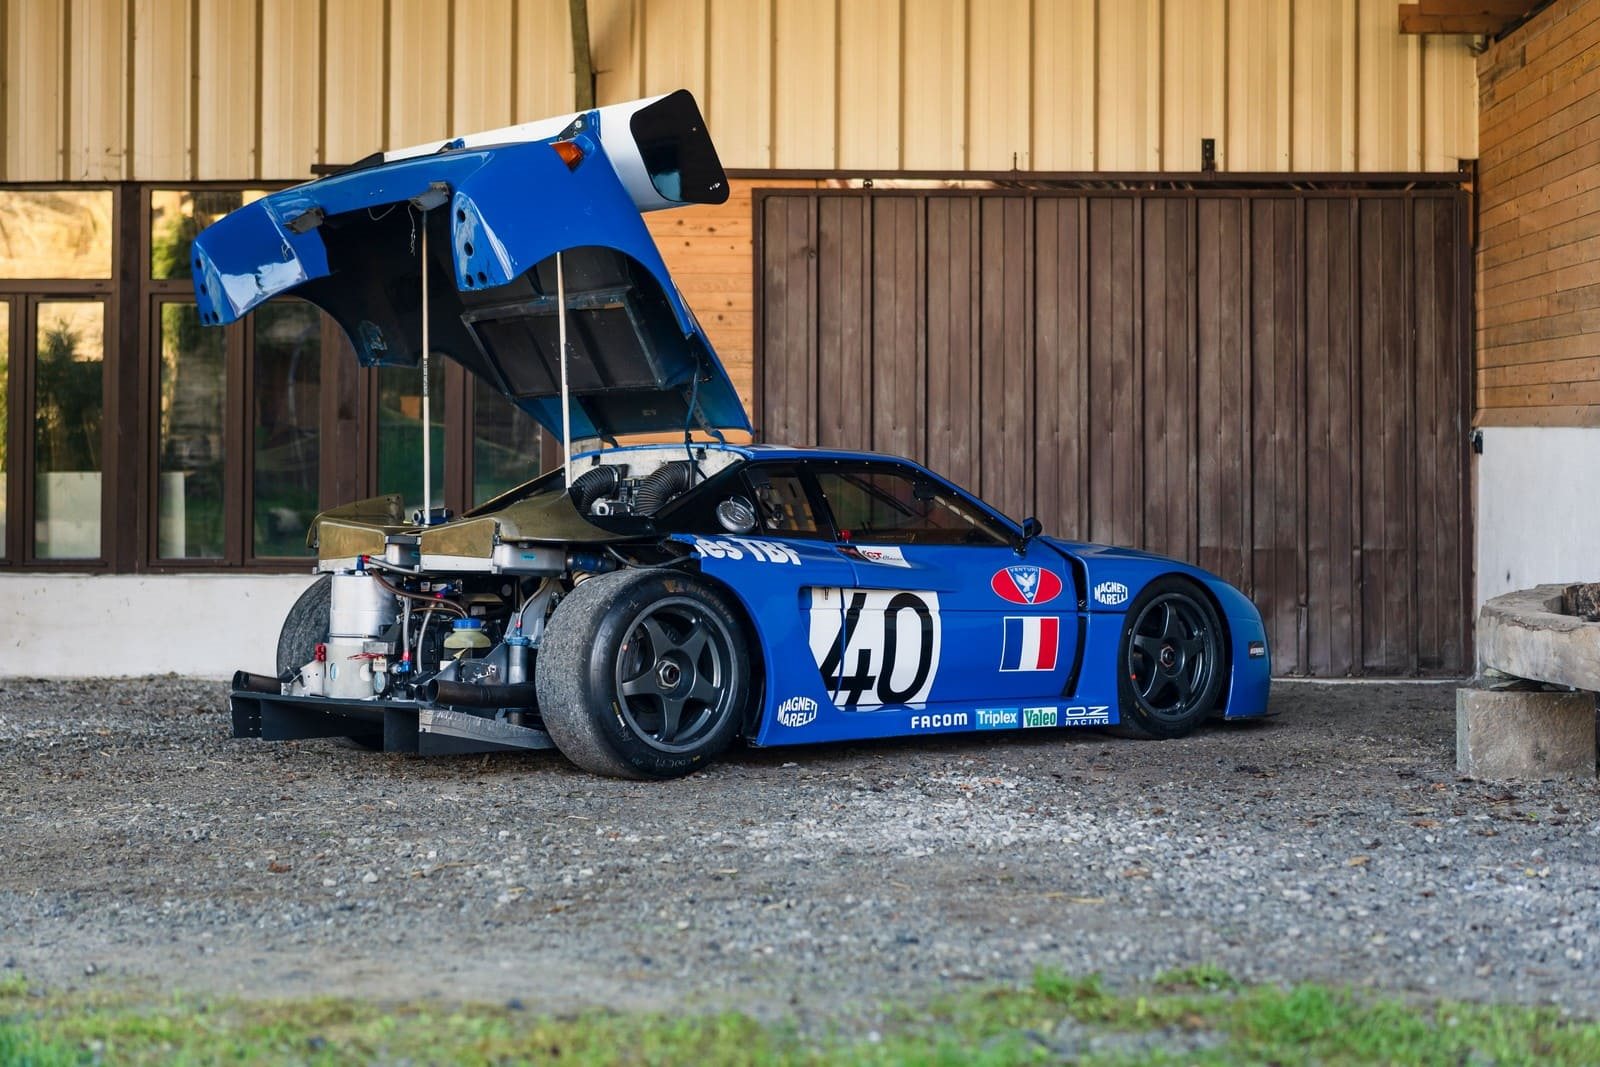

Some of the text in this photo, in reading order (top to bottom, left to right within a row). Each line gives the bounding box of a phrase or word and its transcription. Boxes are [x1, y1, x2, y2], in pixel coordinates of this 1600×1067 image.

[820, 592, 933, 710] 40
[911, 712, 967, 729] FACOM
[977, 710, 1017, 727] Triplex
[1024, 709, 1056, 727] Valeo
[1065, 718, 1109, 726] RACING
